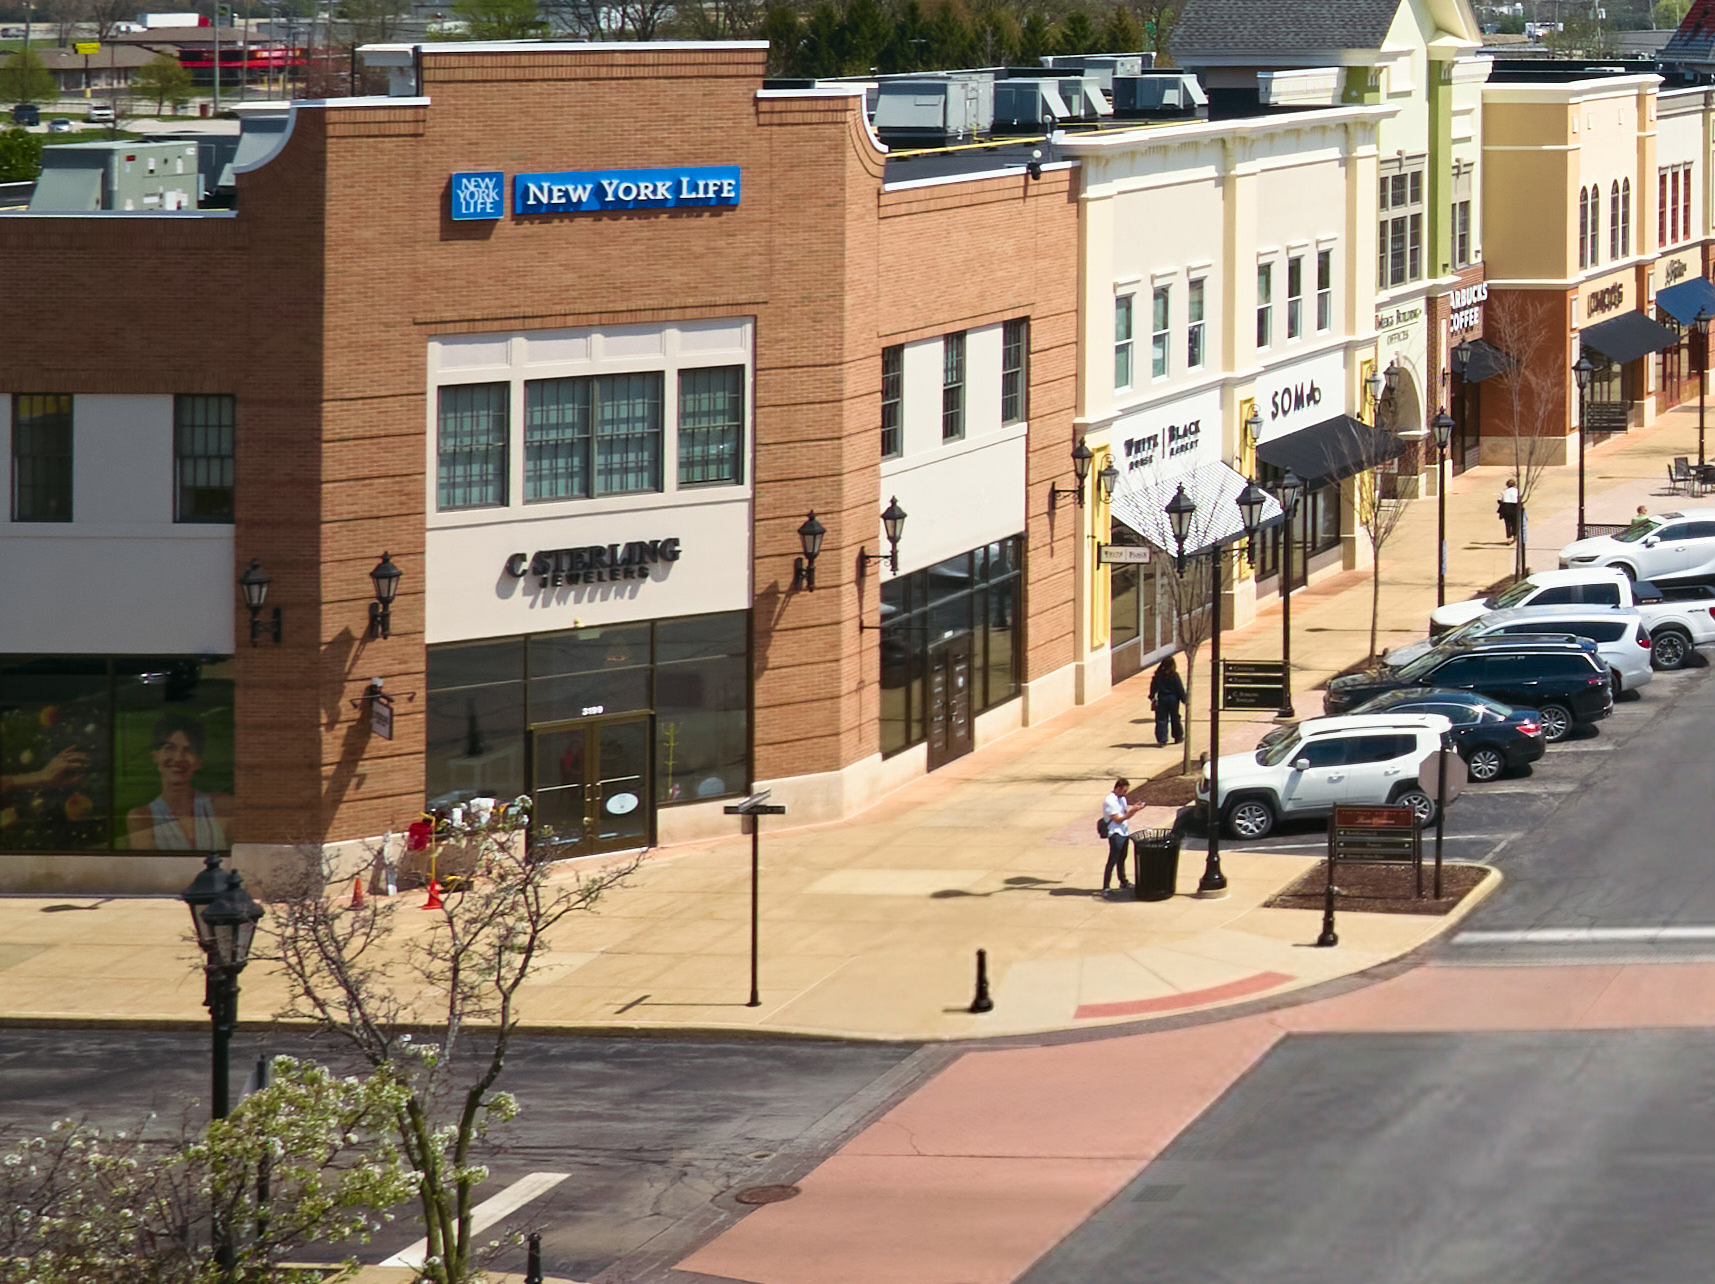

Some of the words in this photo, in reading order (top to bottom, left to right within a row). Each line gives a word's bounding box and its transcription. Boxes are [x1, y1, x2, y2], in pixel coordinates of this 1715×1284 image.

[456, 188, 500, 203] YORK
[461, 177, 496, 191] NEW
[526, 182, 594, 205] NEW
[600, 178, 672, 202] YORK
[679, 176, 736, 201] LIFE
[461, 200, 495, 214] LIFE
[1167, 420, 1202, 444] BLACK
[506, 553, 528, 578] C
[532, 537, 682, 576] STERLING
[539, 565, 650, 589] JEWELERS
